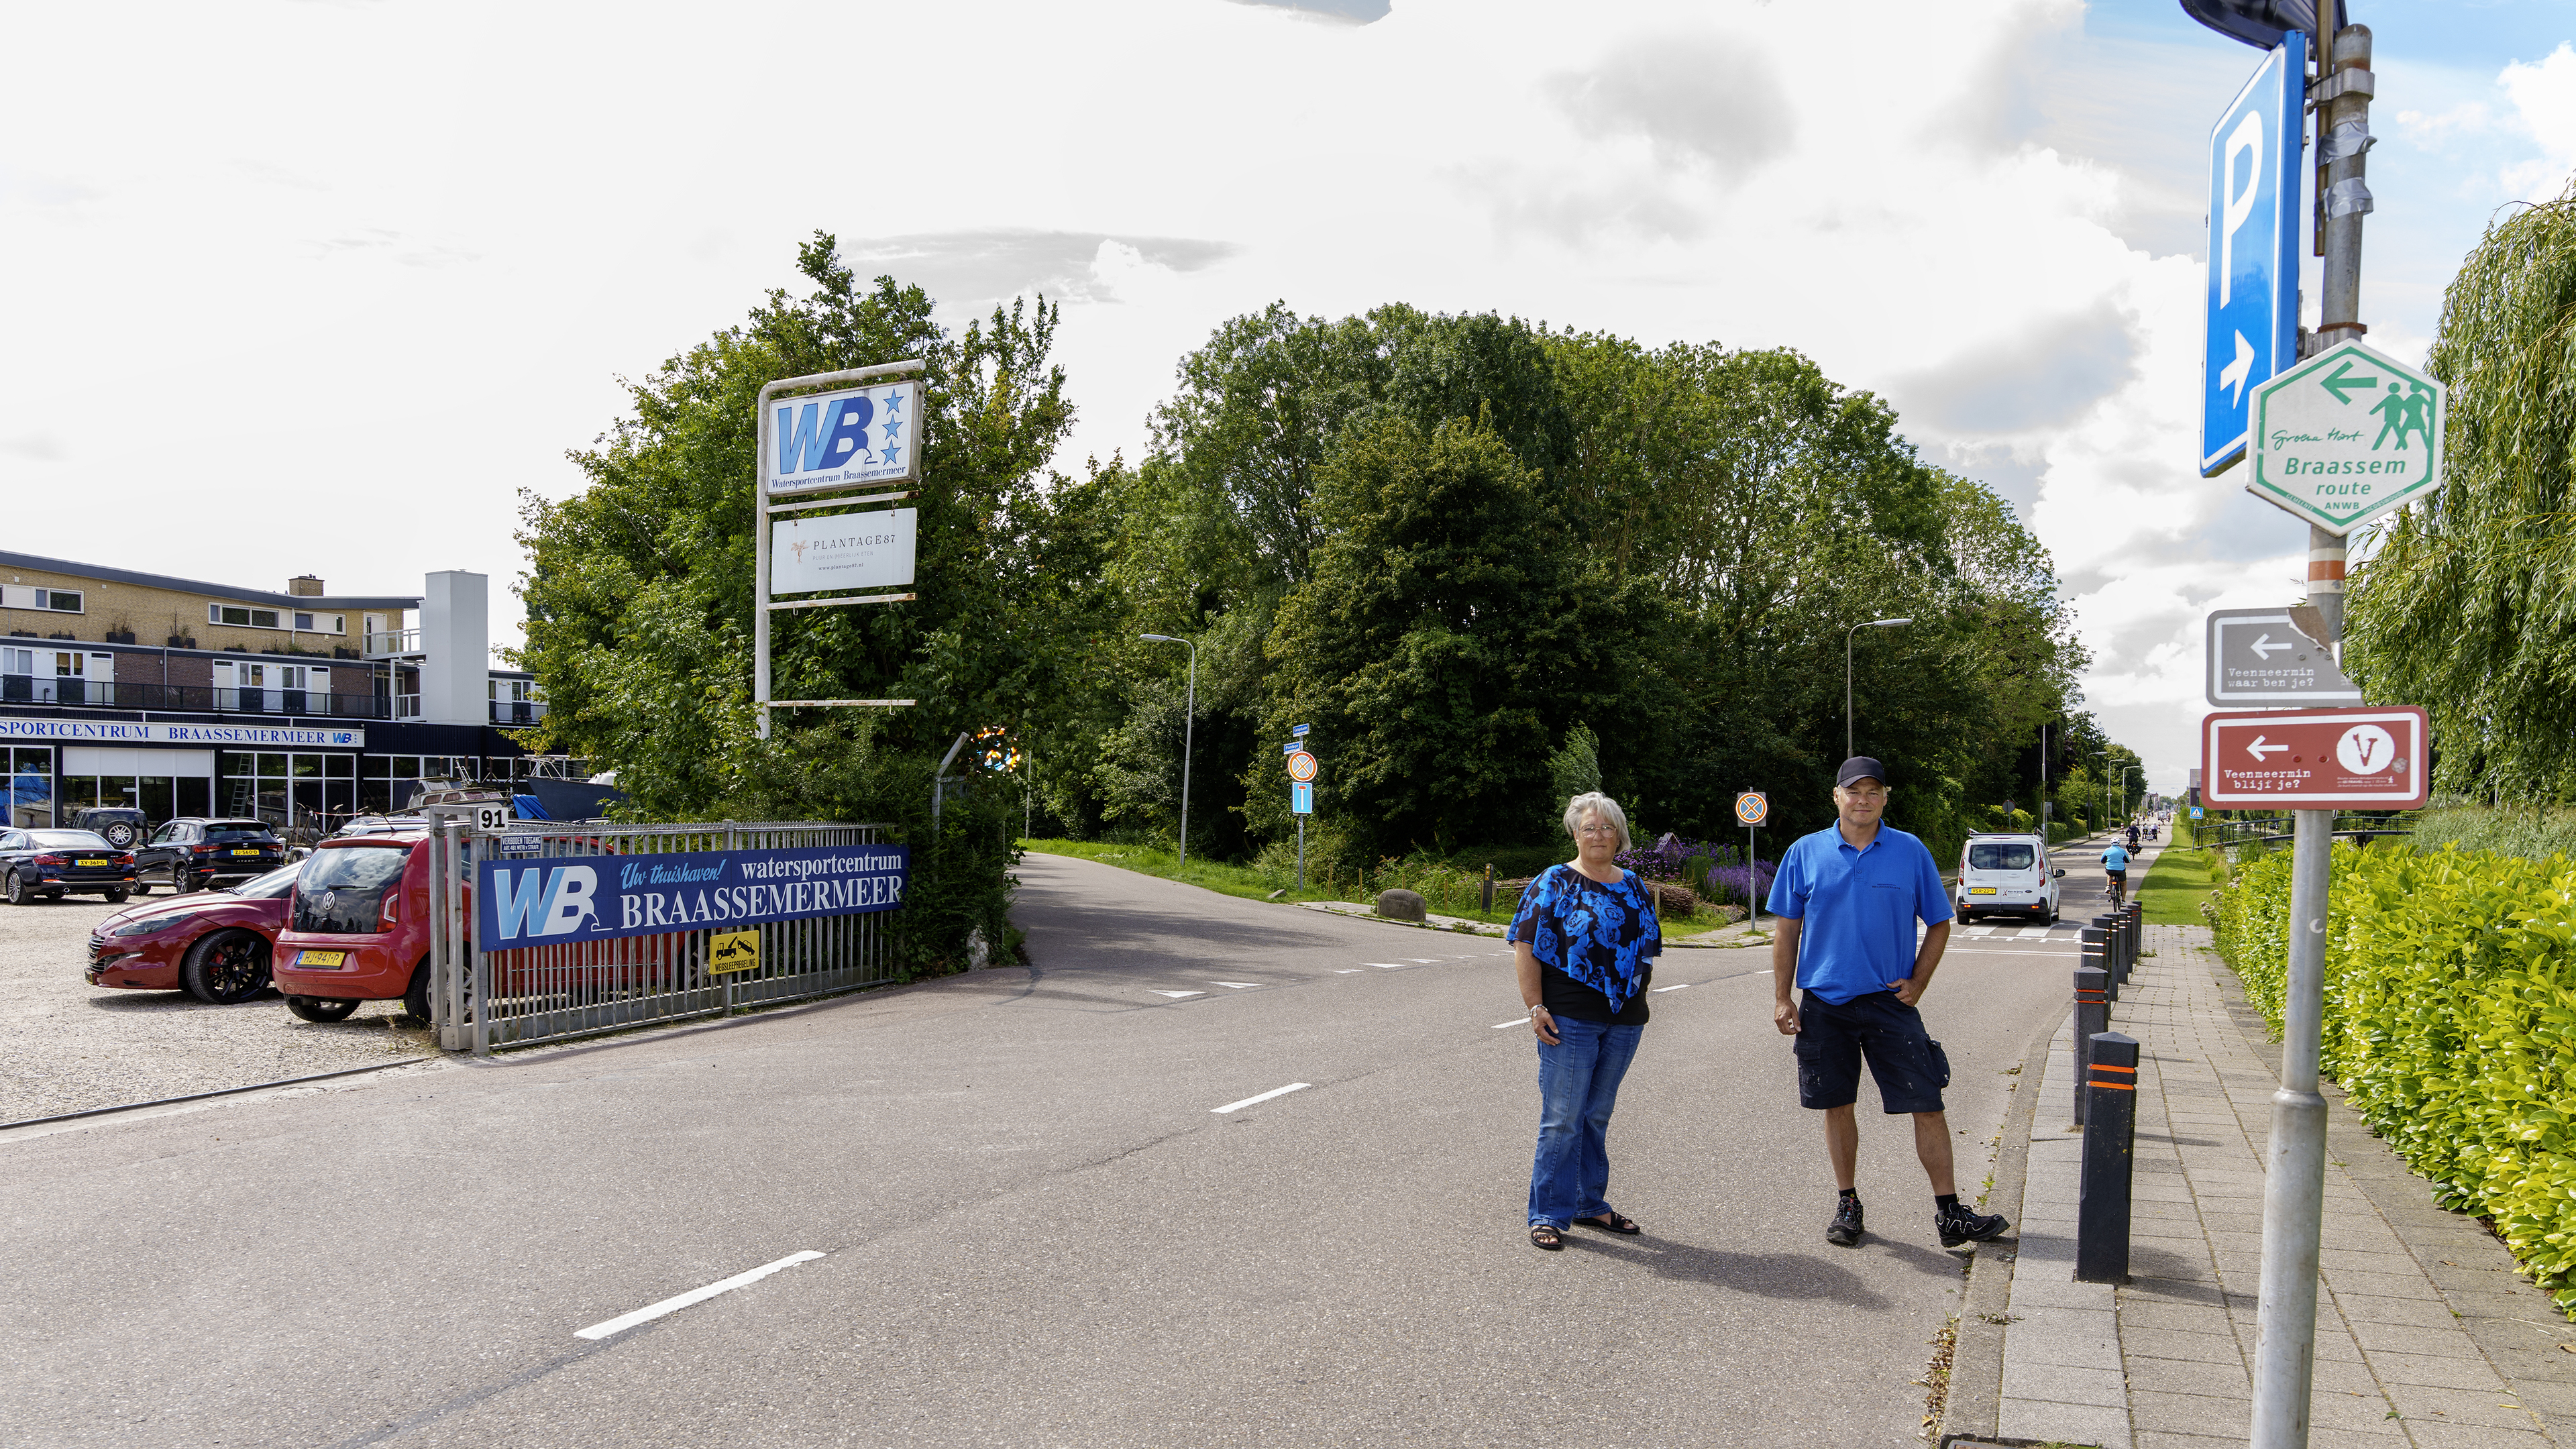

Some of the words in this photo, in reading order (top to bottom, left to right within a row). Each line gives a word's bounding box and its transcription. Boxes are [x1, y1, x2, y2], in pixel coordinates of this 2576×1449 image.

[2220, 110, 2263, 310] P
[778, 396, 874, 475] WB
[2271, 429, 2324, 450] Groene
[2327, 427, 2364, 442] Hart
[2284, 458, 2406, 475] Braassem
[771, 473, 841, 488] Watersportcentrum
[843, 466, 906, 480] Braassemermeer
[2316, 482, 2371, 495] route
[2324, 502, 2360, 510] ANWB
[813, 534, 896, 550] PLANTAGE87
[818, 562, 864, 571] www.plantage87.nl
[2227, 667, 2314, 678] Veenmeermin
[2227, 679, 2259, 688] waar
[2263, 678, 2286, 687] ben
[2291, 678, 2314, 689] je?
[0, 721, 150, 739] SPORTCENTRUM
[168, 727, 325, 743] BRAASSEMERMEER
[2224, 769, 2311, 779] Veenmeermin
[2233, 780, 2273, 791] blijf
[2277, 780, 2300, 791] je?
[482, 809, 506, 828] 91
[502, 837, 523, 845] VERBODEN
[523, 836, 541, 845] TOEGANG
[621, 861, 647, 890] Uw
[650, 858, 727, 885] thuishaven!
[741, 852, 902, 881] watersportcentrum
[493, 865, 598, 940] WB
[620, 875, 902, 930] BRAASSEMERMEER
[304, 953, 339, 964] HJ-941-P
[714, 958, 756, 972] WEGSLEEPREGELING
